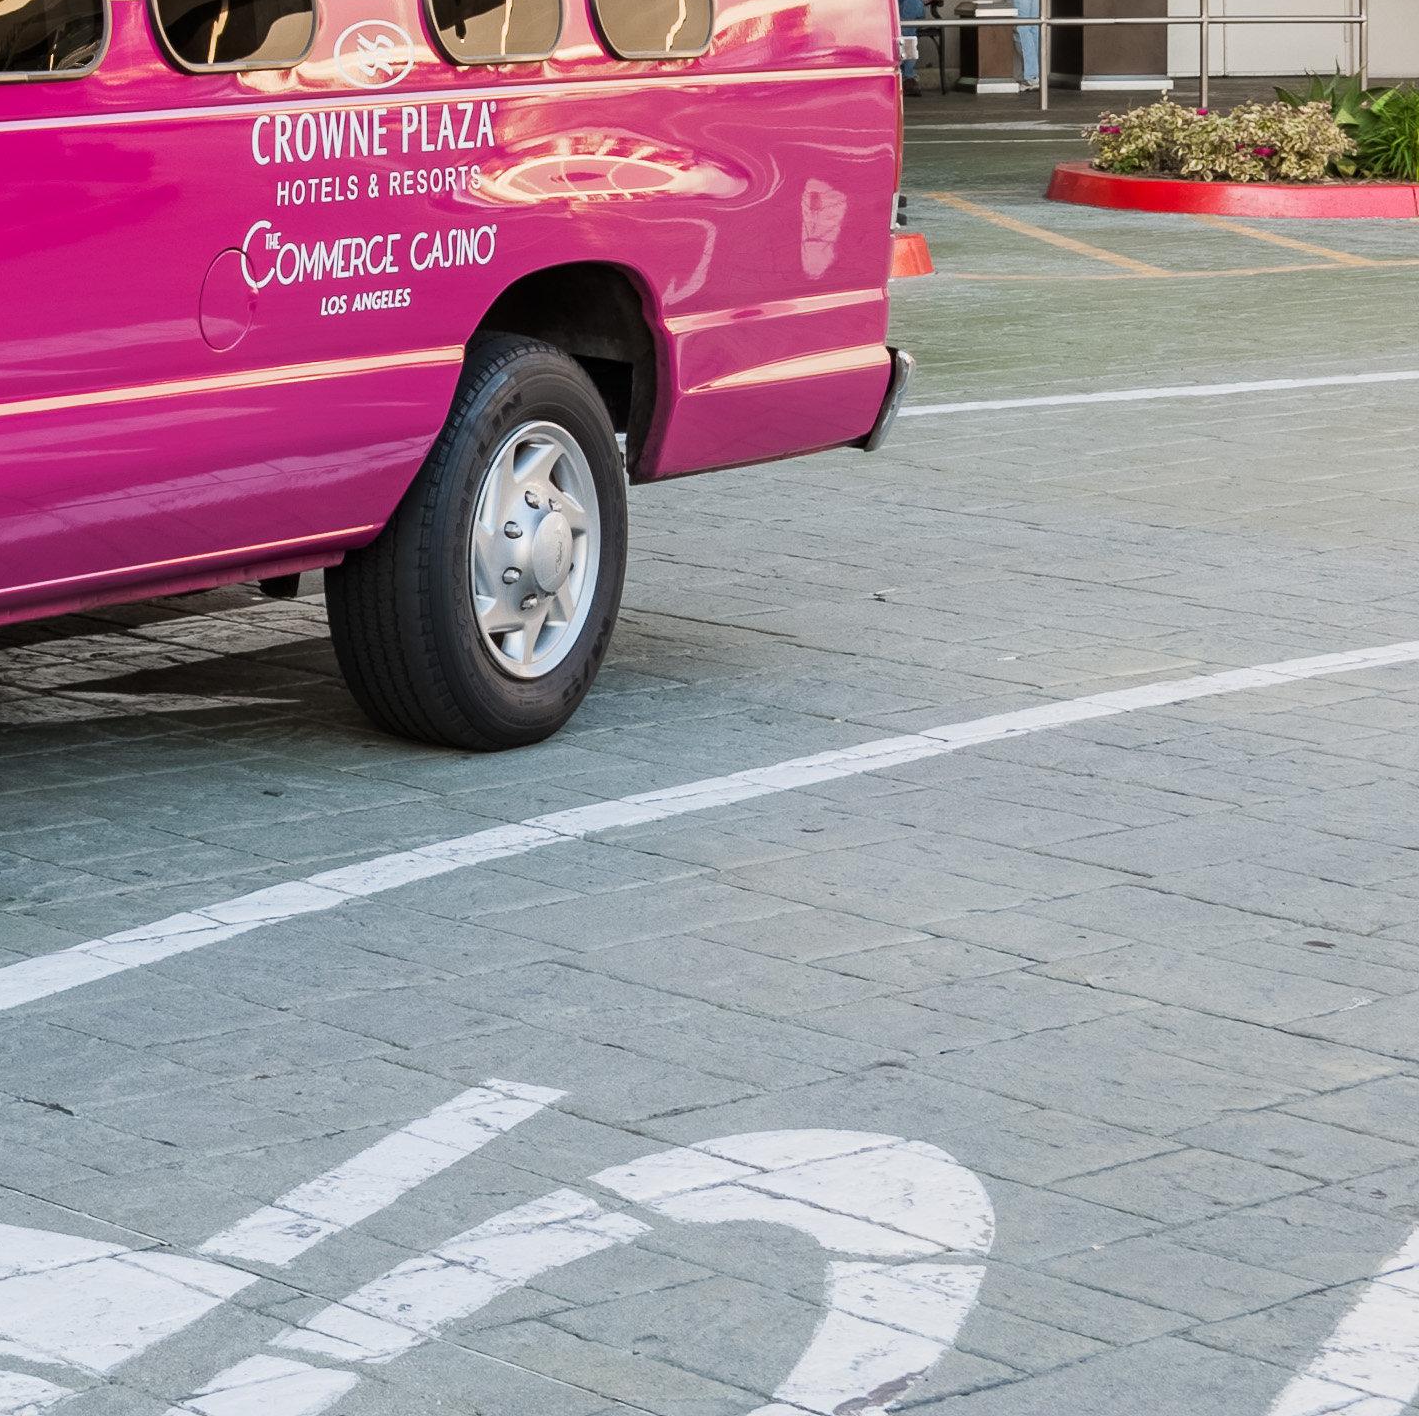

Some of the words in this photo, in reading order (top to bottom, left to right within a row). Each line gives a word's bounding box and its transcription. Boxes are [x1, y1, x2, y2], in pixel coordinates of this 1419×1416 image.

[251, 108, 388, 166] CROWNE
[276, 175, 359, 207] HOTELS
[367, 173, 380, 198] &
[388, 164, 482, 196] RESORTS
[240, 219, 402, 289] COMMERCE
[320, 294, 347, 316] LOS
[351, 287, 412, 312] ANGELES
